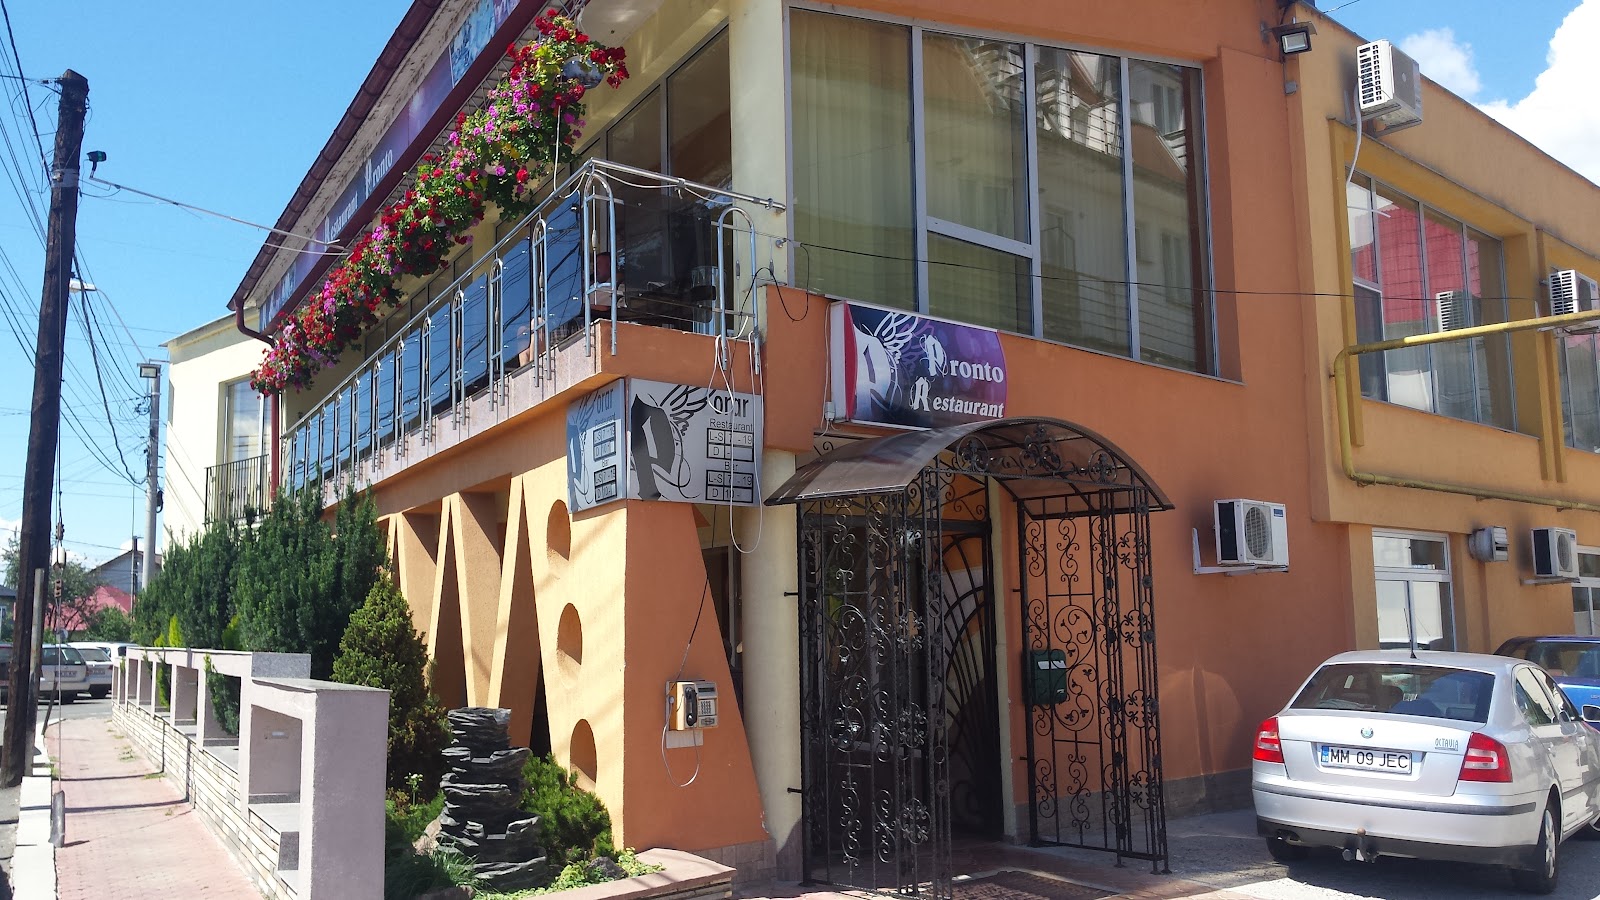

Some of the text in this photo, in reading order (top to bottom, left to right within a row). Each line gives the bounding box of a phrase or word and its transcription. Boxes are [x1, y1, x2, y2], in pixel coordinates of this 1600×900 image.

[919, 333, 1004, 383] Pronto
[910, 376, 1005, 418] Restaurant
[709, 418, 754, 432] Restaurant
[713, 446, 720, 456] D
[712, 487, 719, 498] D
[1330, 748, 1408, 769] MM 09 JEC
